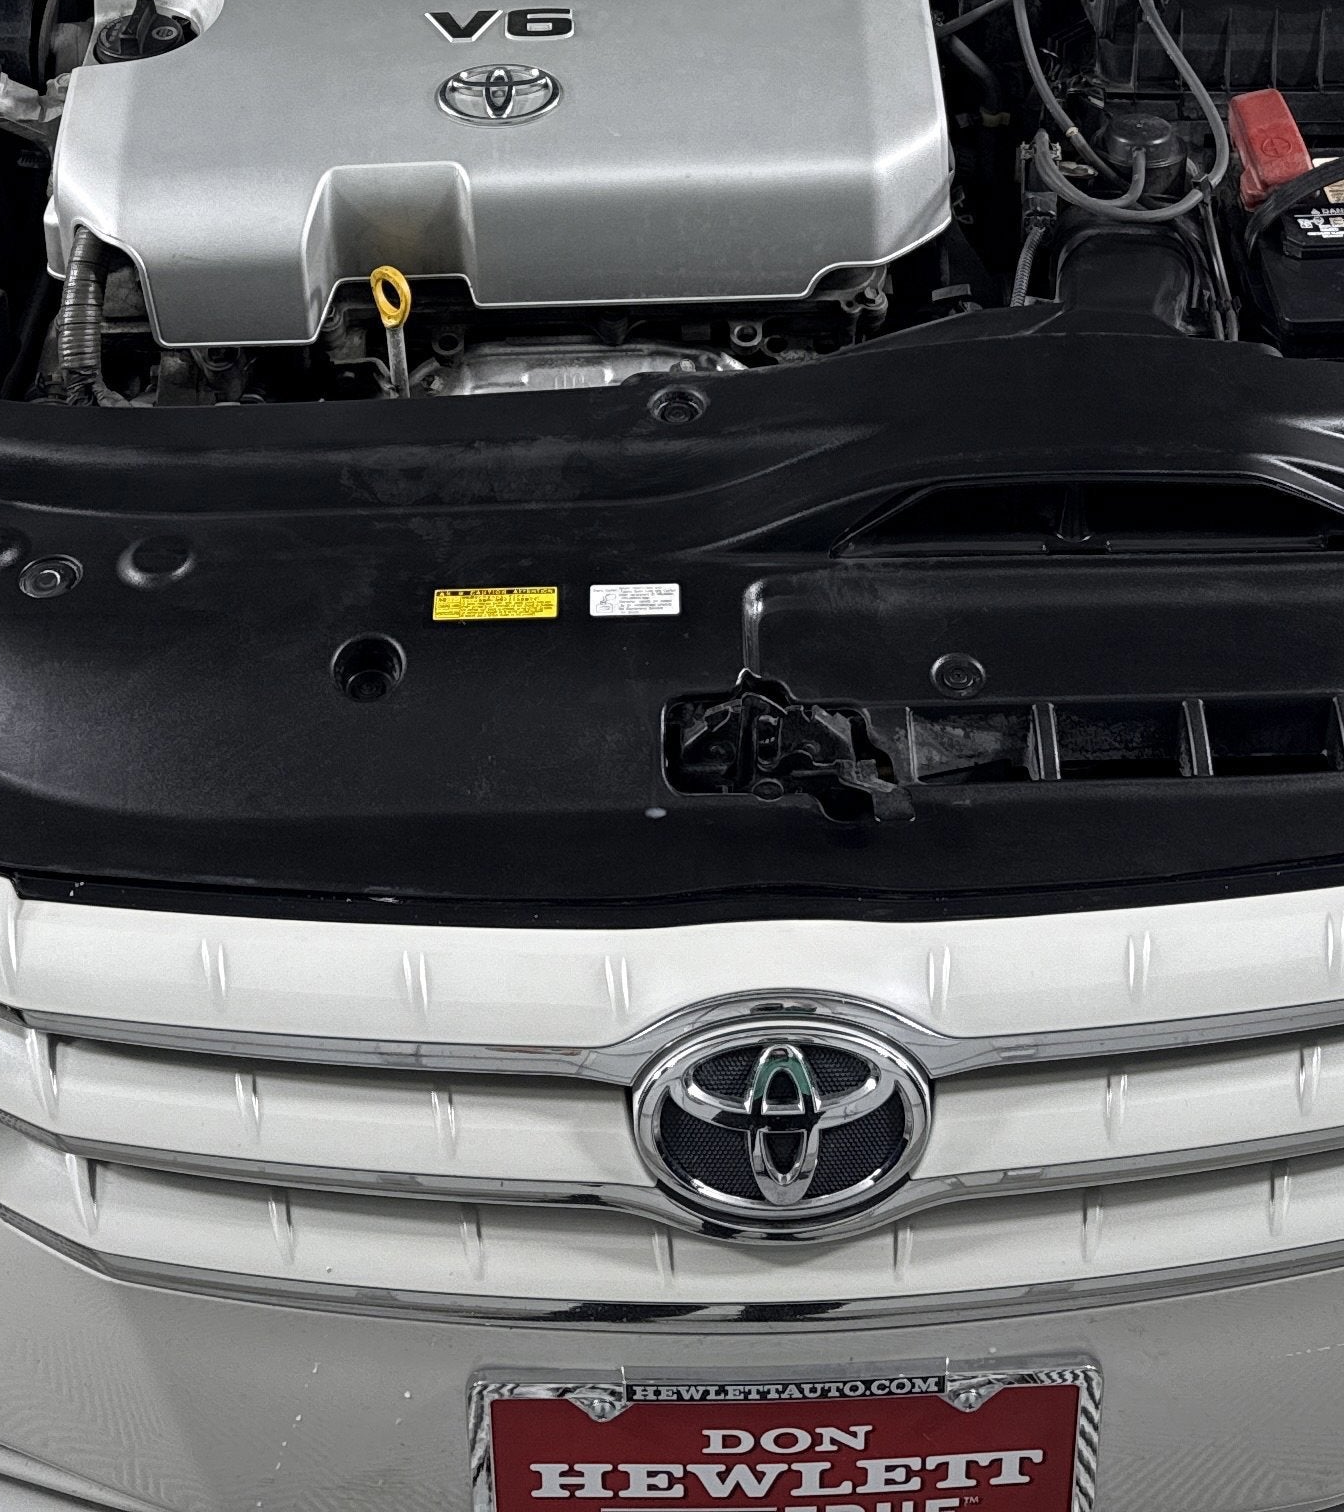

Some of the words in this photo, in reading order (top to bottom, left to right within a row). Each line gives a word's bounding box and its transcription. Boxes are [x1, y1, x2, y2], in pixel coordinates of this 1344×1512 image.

[424, 6, 575, 43] V6
[631, 1376, 940, 1401] HEWLETTAUTO.COM
[700, 1424, 874, 1454] DON
[528, 1449, 1044, 1499] HEWLETT
